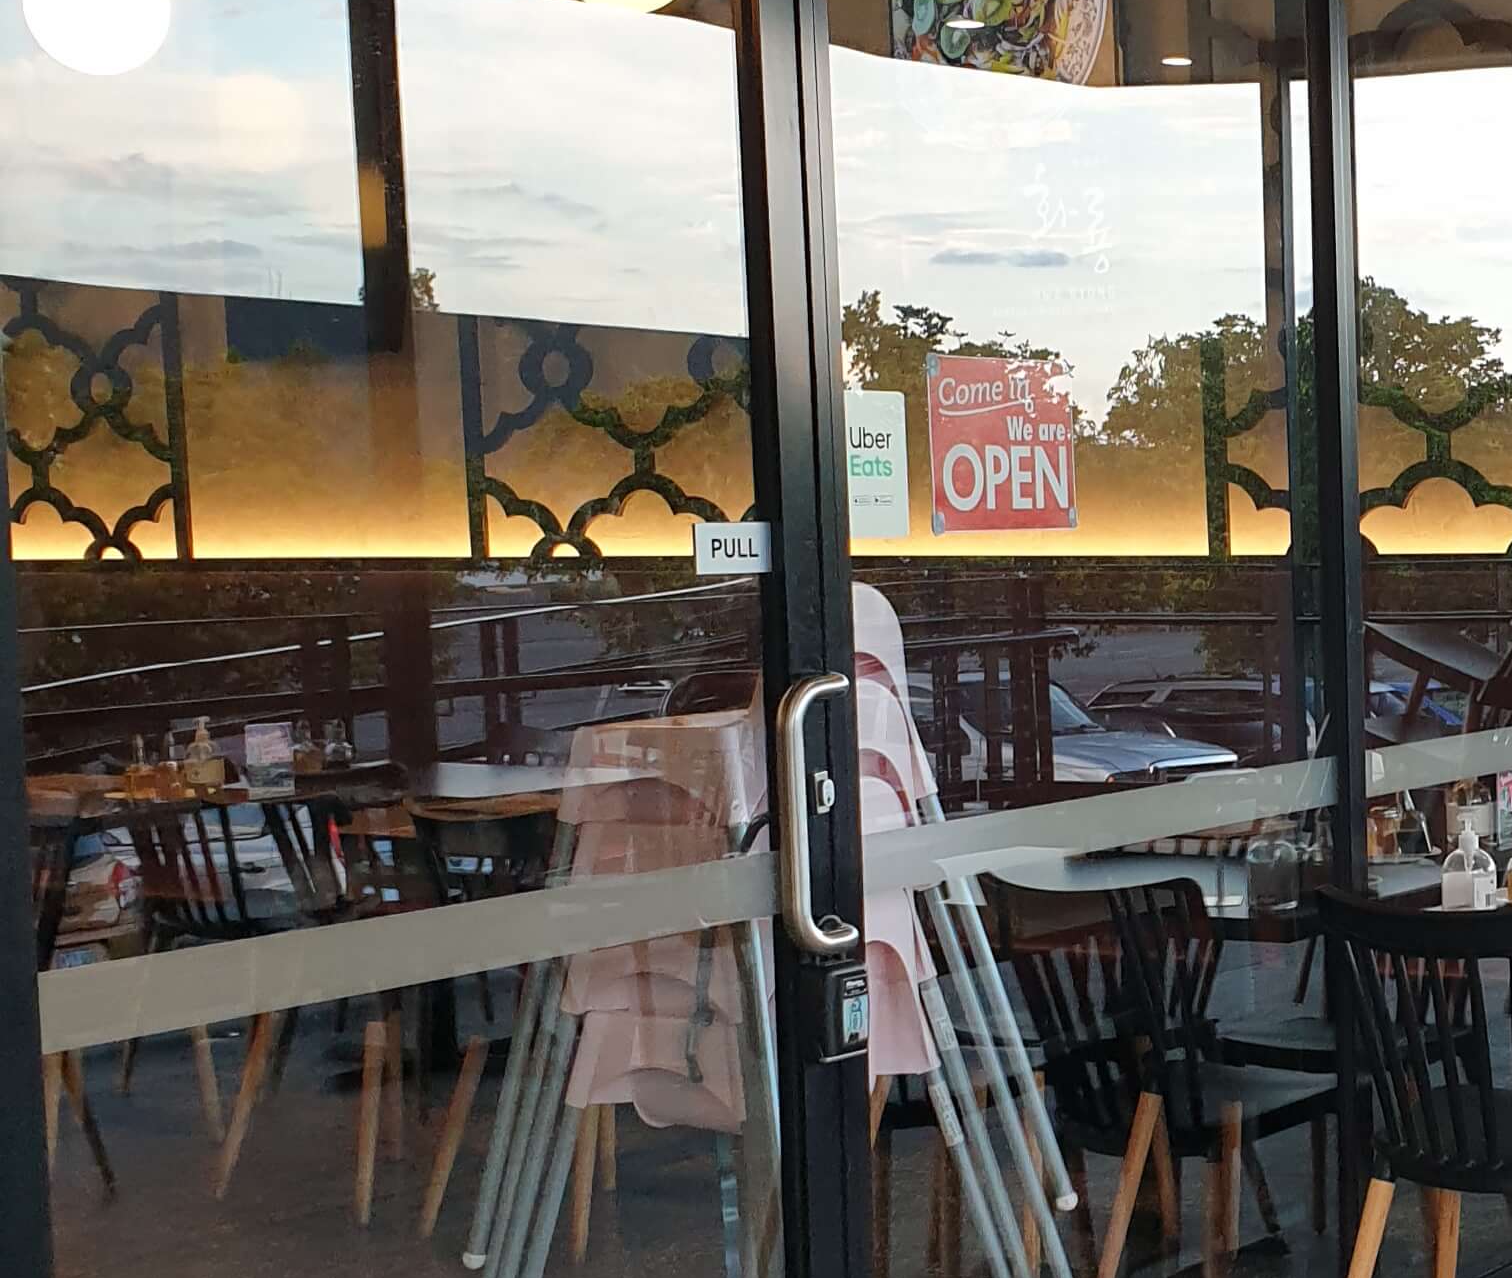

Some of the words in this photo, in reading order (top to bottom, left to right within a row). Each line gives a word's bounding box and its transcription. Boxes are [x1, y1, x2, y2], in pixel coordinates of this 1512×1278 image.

[938, 377, 1004, 405] Come
[849, 426, 892, 450] Uber
[1006, 415, 1033, 441] We
[1038, 423, 1065, 441] are
[849, 454, 893, 478] Eats
[942, 443, 1069, 512] OPEN
[711, 537, 760, 559] PULL
